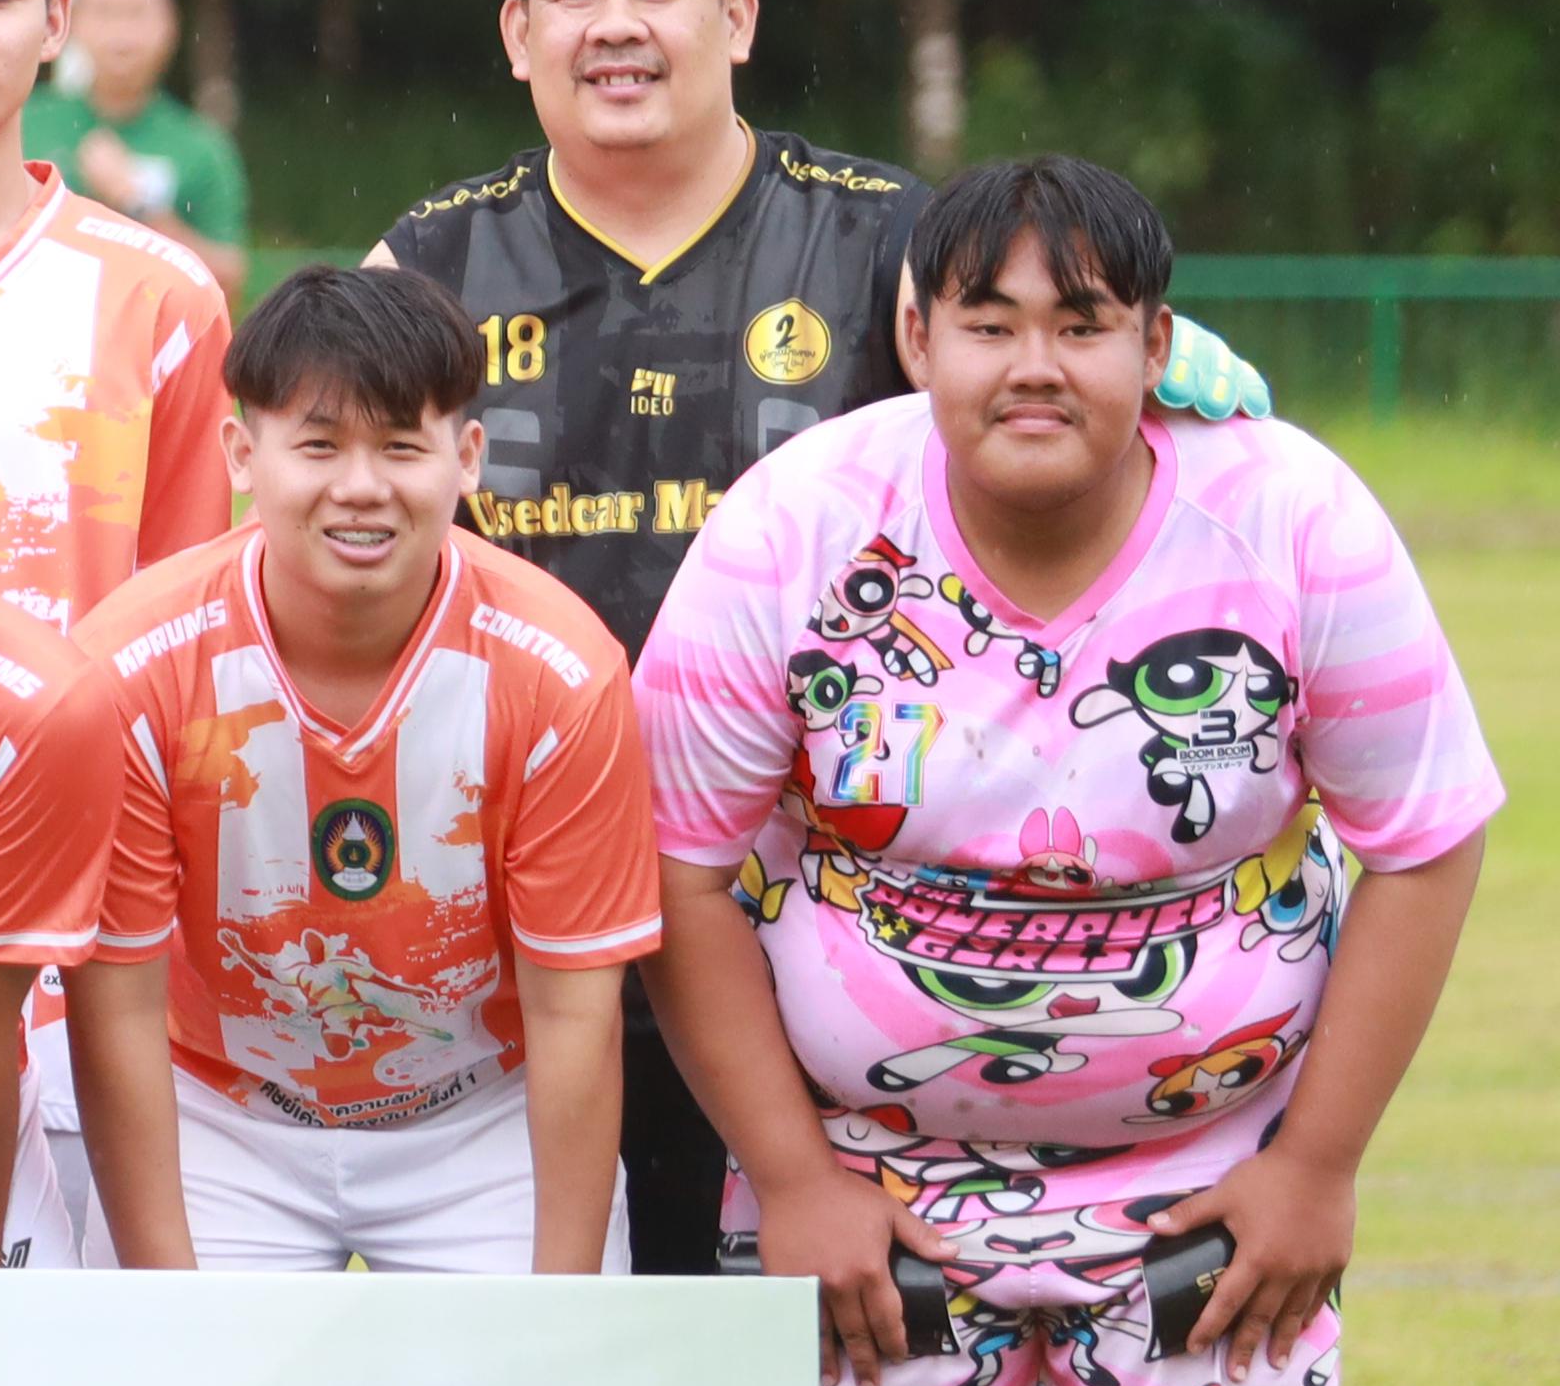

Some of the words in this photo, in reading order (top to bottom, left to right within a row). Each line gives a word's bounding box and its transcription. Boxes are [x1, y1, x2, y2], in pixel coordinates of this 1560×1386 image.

[781, 150, 902, 194] Usedcar
[477, 314, 548, 387] 18
[630, 395, 674, 416] IDEO
[467, 482, 644, 537] Usedcar
[113, 599, 228, 679] KPRUMS
[469, 602, 591, 689] COMTMS
[828, 701, 949, 808] 27
[43, 973, 63, 987] 2X
[467, 1072, 477, 1085] 1
